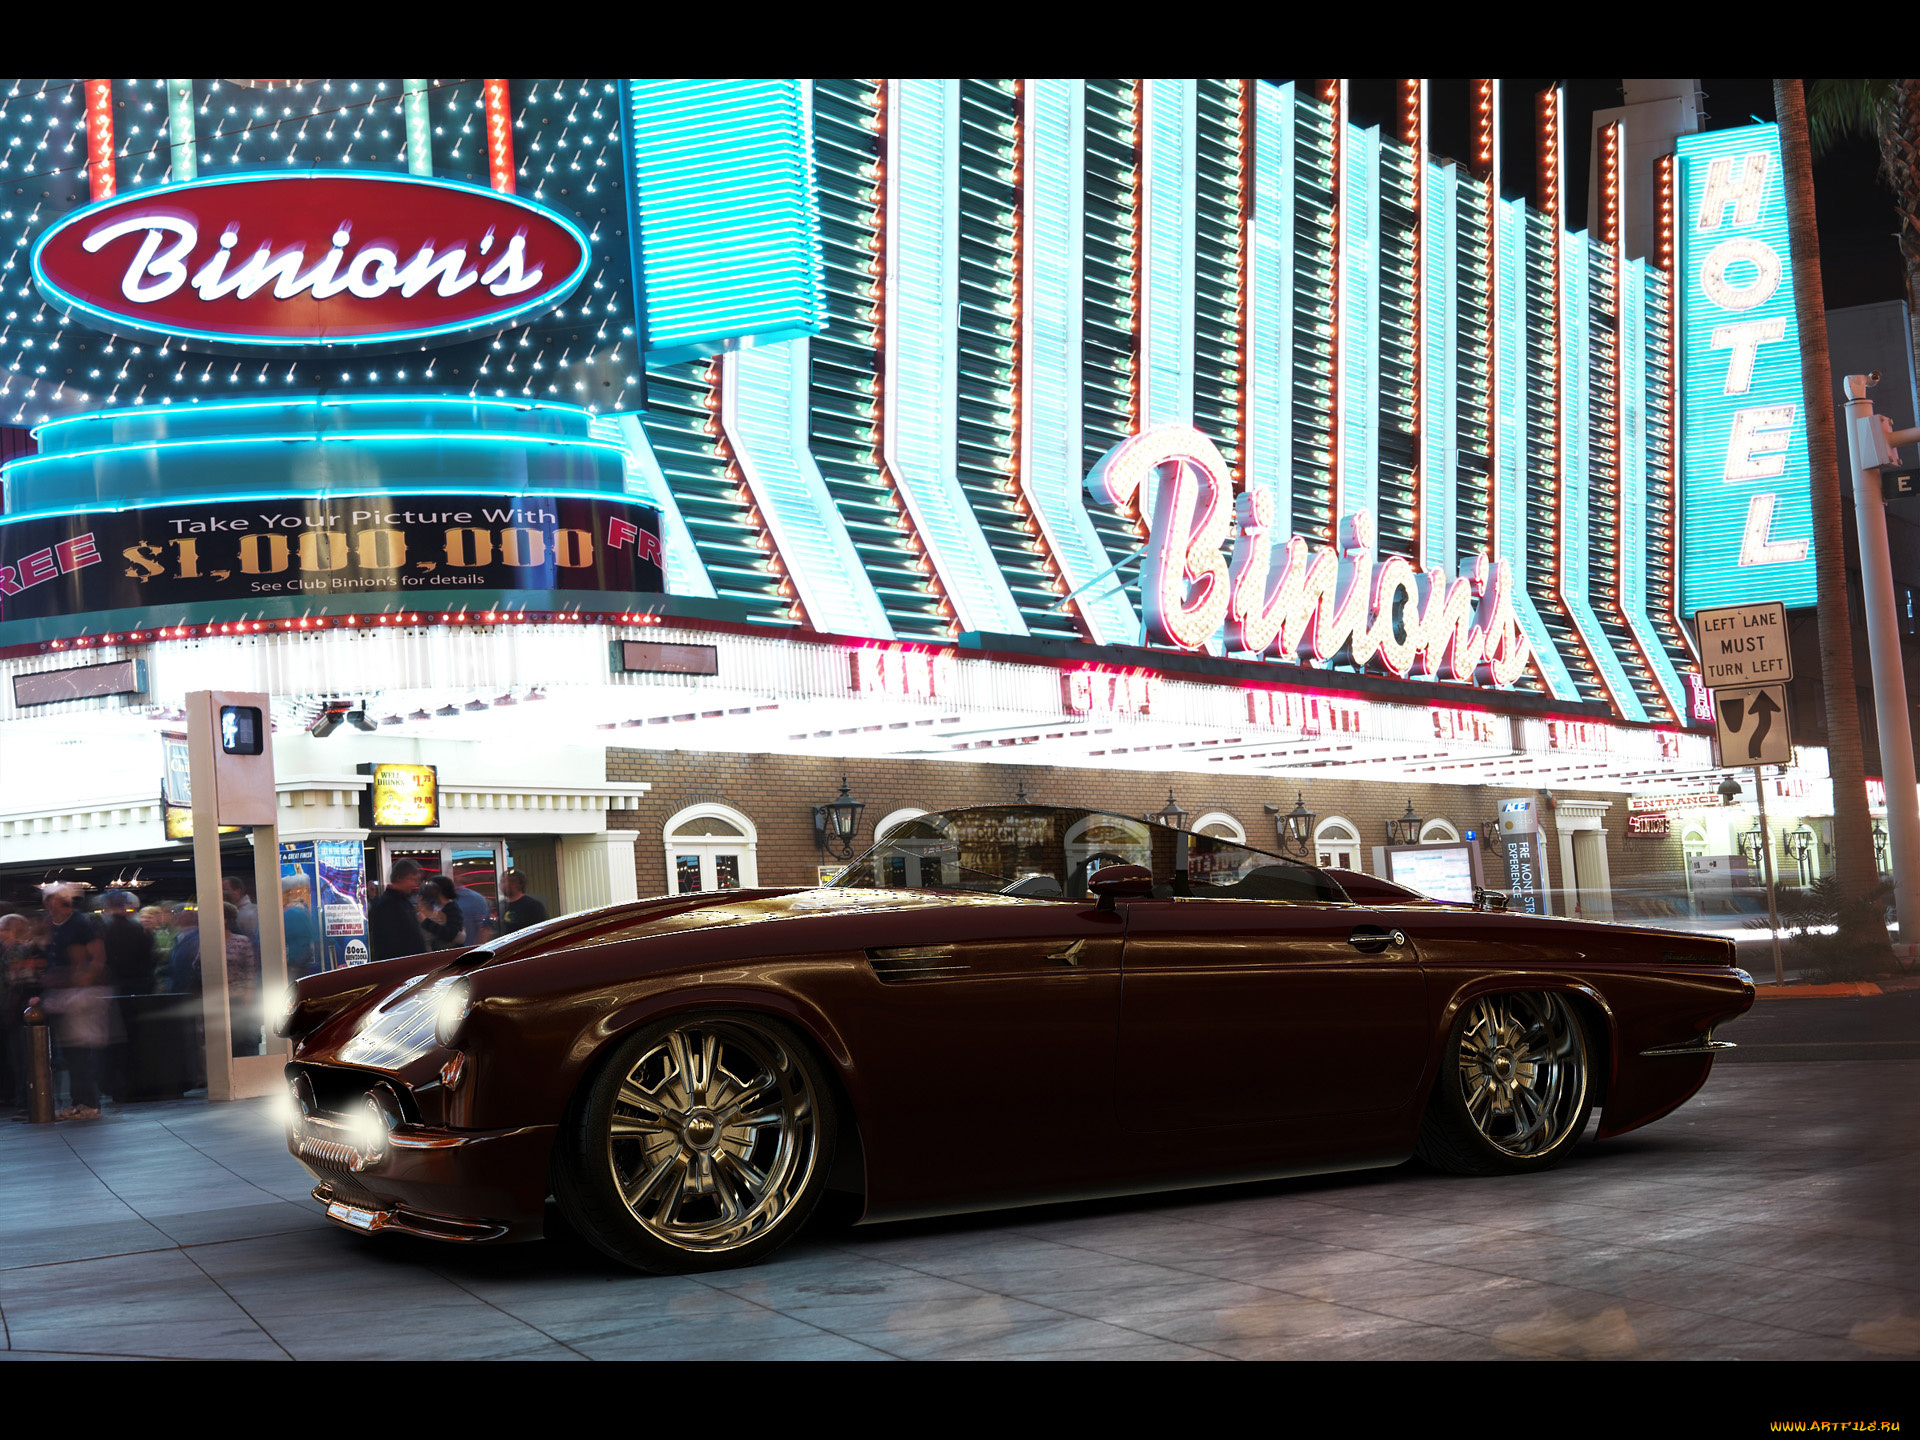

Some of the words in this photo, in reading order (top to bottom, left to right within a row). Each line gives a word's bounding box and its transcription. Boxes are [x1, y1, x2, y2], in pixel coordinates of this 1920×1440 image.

[82, 215, 543, 302] Binion's
[1699, 152, 1809, 567] HOTEL
[1897, 475, 1912, 492] E
[168, 517, 249, 534] Take
[259, 513, 341, 529] Your
[352, 509, 479, 526] Picture
[481, 508, 556, 524] With
[122, 527, 595, 583] $1,000,000
[1086, 425, 1530, 689] Binion's
[251, 582, 282, 592] See
[287, 579, 327, 590] Club
[332, 576, 397, 588] Binion's
[401, 575, 428, 586] for
[430, 574, 485, 585] details
[1704, 617, 1735, 631] LEFT
[1743, 612, 1777, 628] LANE
[1721, 636, 1765, 654] MUST
[1708, 662, 1743, 677] TURN
[1752, 658, 1783, 673] LEFT
[1633, 795, 1719, 808] ENTRANCE
[1508, 842, 1522, 899] EXPERIENCE
